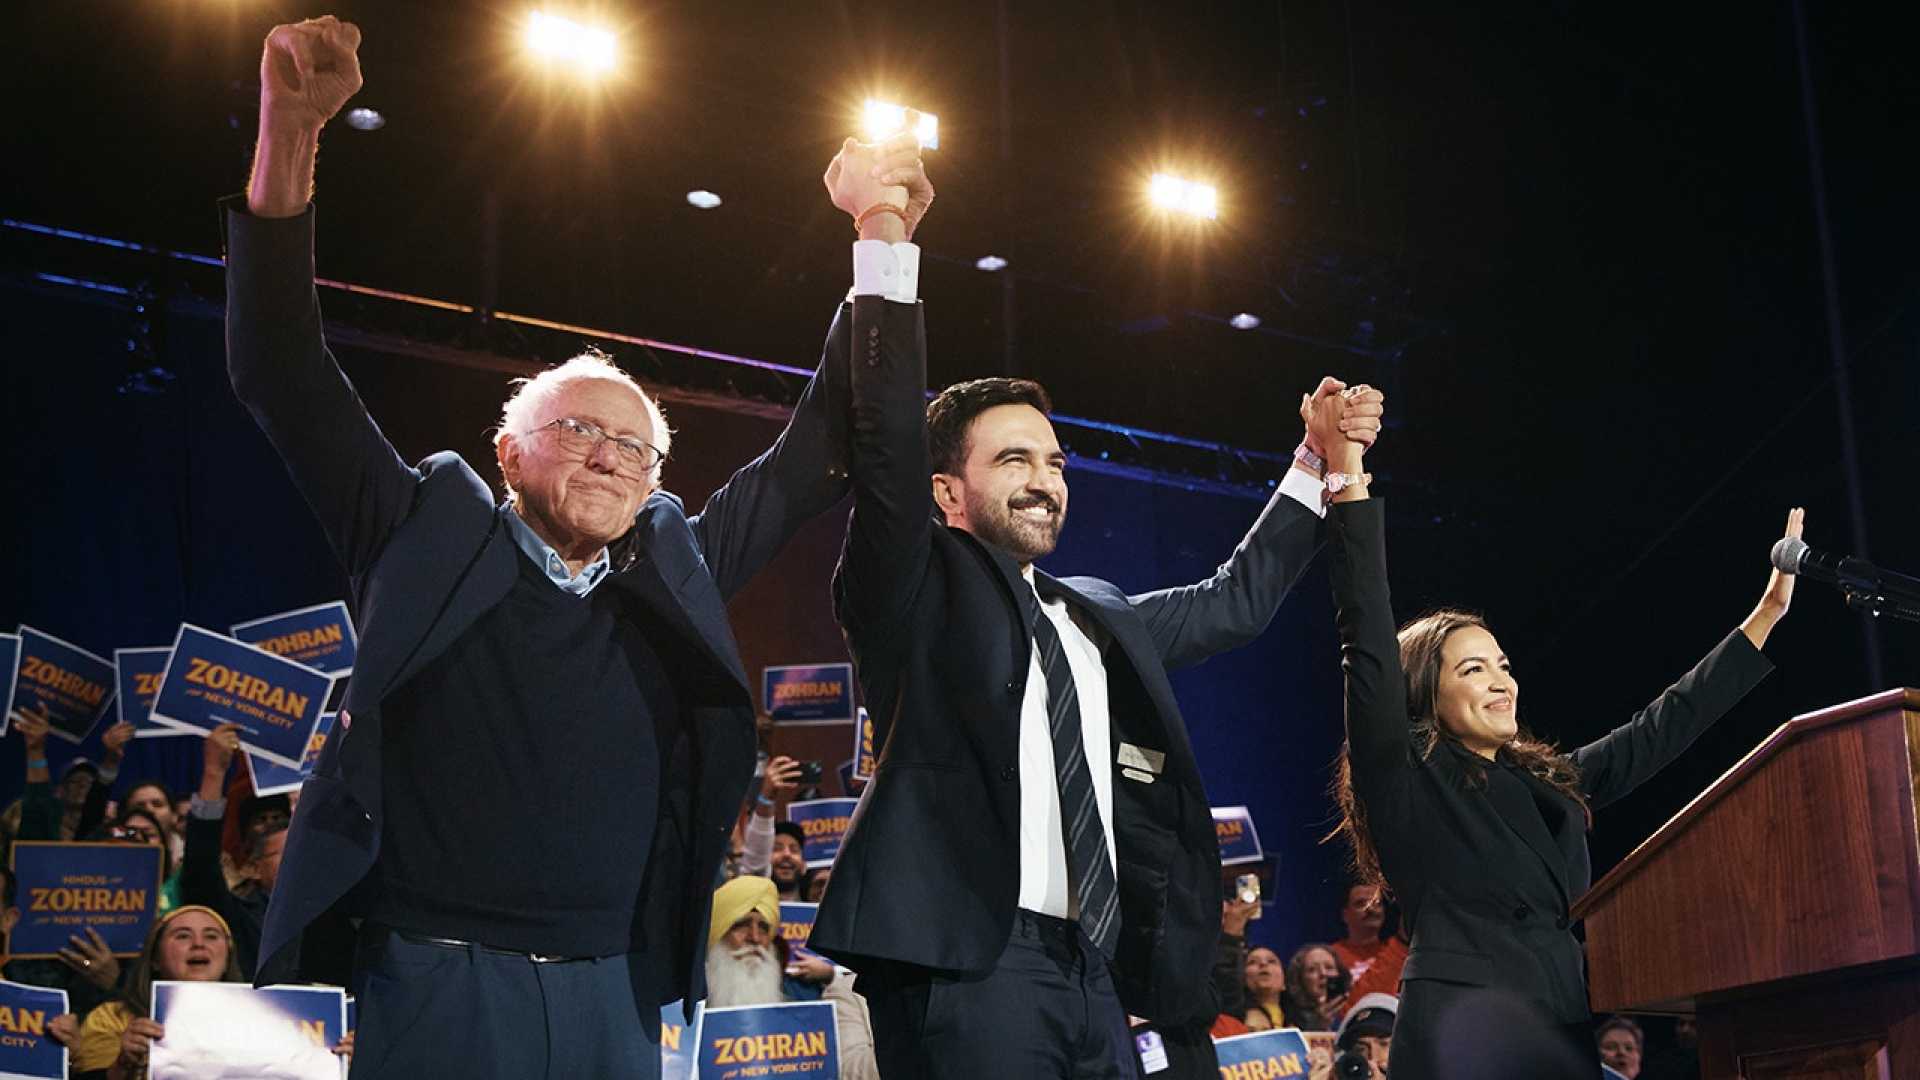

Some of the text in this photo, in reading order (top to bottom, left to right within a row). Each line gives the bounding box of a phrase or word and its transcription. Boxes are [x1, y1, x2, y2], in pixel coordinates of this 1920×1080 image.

[21, 655, 104, 704] ZOHRAN
[185, 657, 309, 719] ZOHRAN
[773, 682, 841, 698] ZOHRAN
[30, 887, 146, 912] ZOHRAN
[1, 1036, 37, 1049] CITY
[714, 1031, 827, 1065] ZOHRAN
[740, 1065, 769, 1078] NEW
[771, 1063, 798, 1074] YORK
[799, 1060, 824, 1073] CITY
